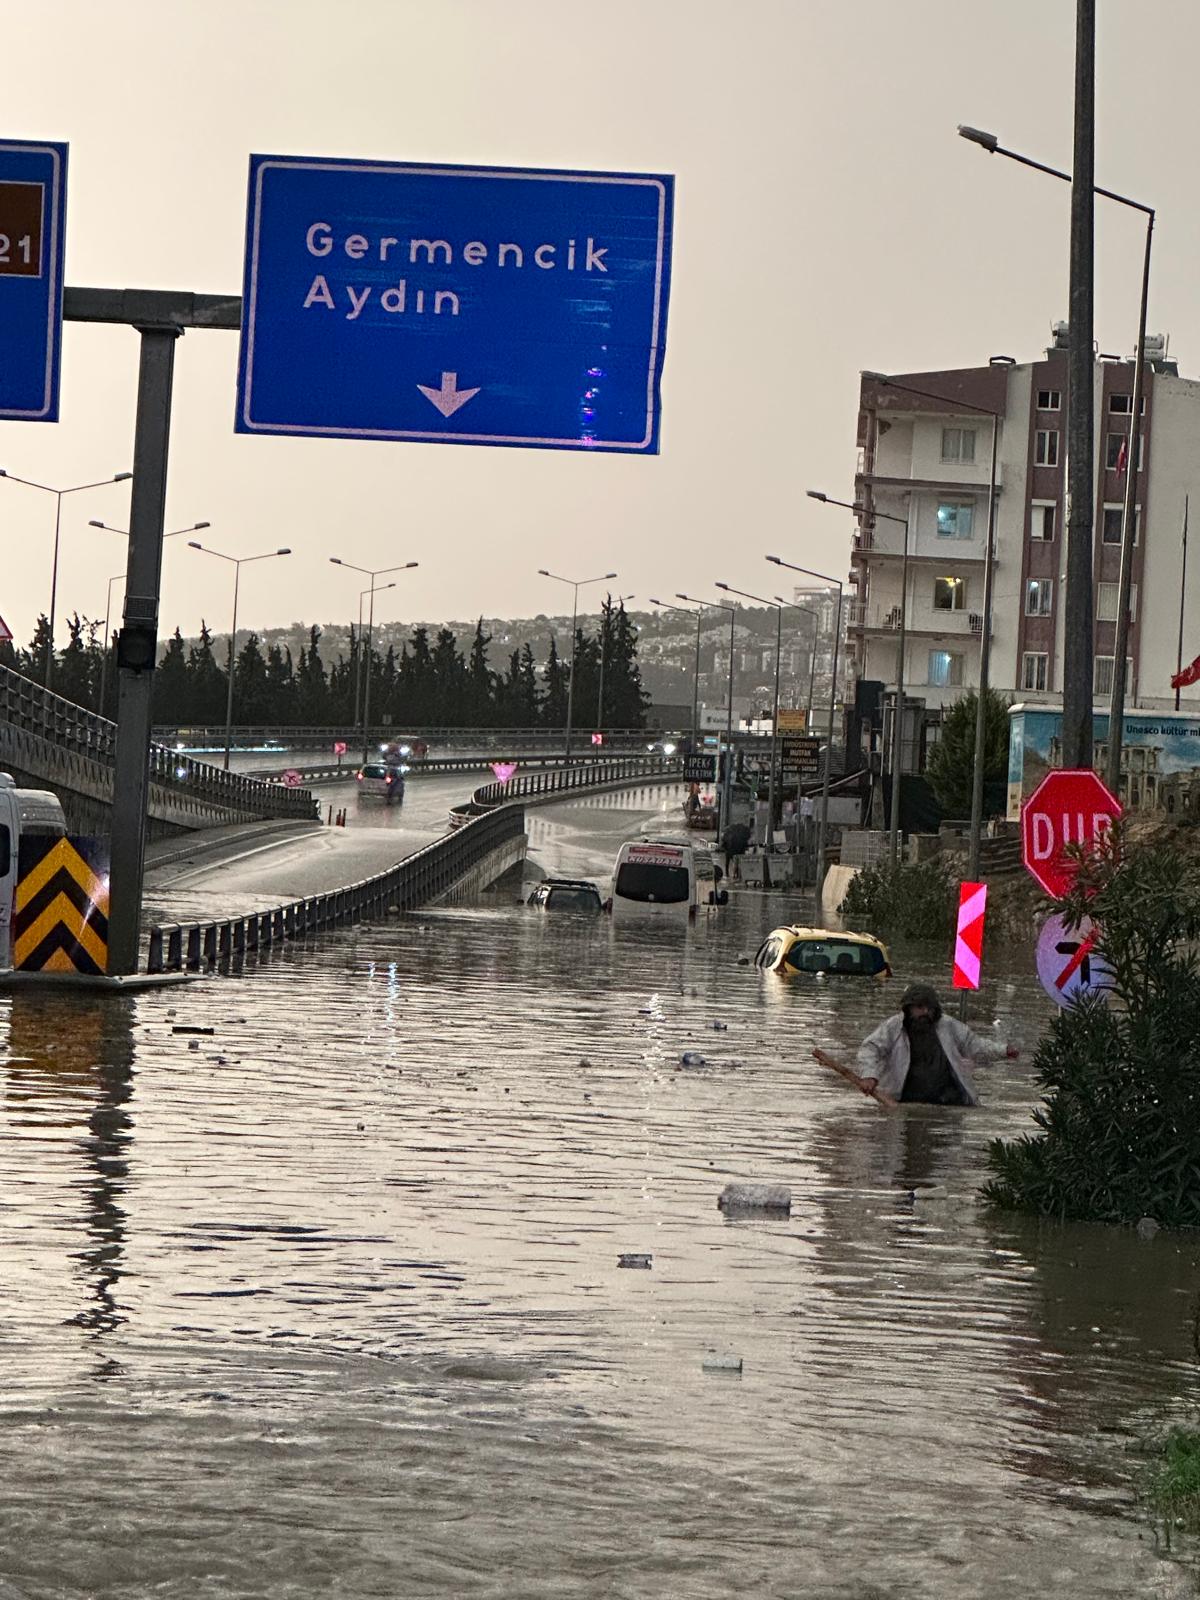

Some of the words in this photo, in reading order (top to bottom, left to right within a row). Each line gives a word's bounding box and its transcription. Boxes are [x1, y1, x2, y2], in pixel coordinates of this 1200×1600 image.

[306, 222, 608, 272] Germencik
[303, 274, 460, 320] Aydın
[1126, 725, 1159, 735] Unesco
[1032, 813, 1114, 860] DUR
